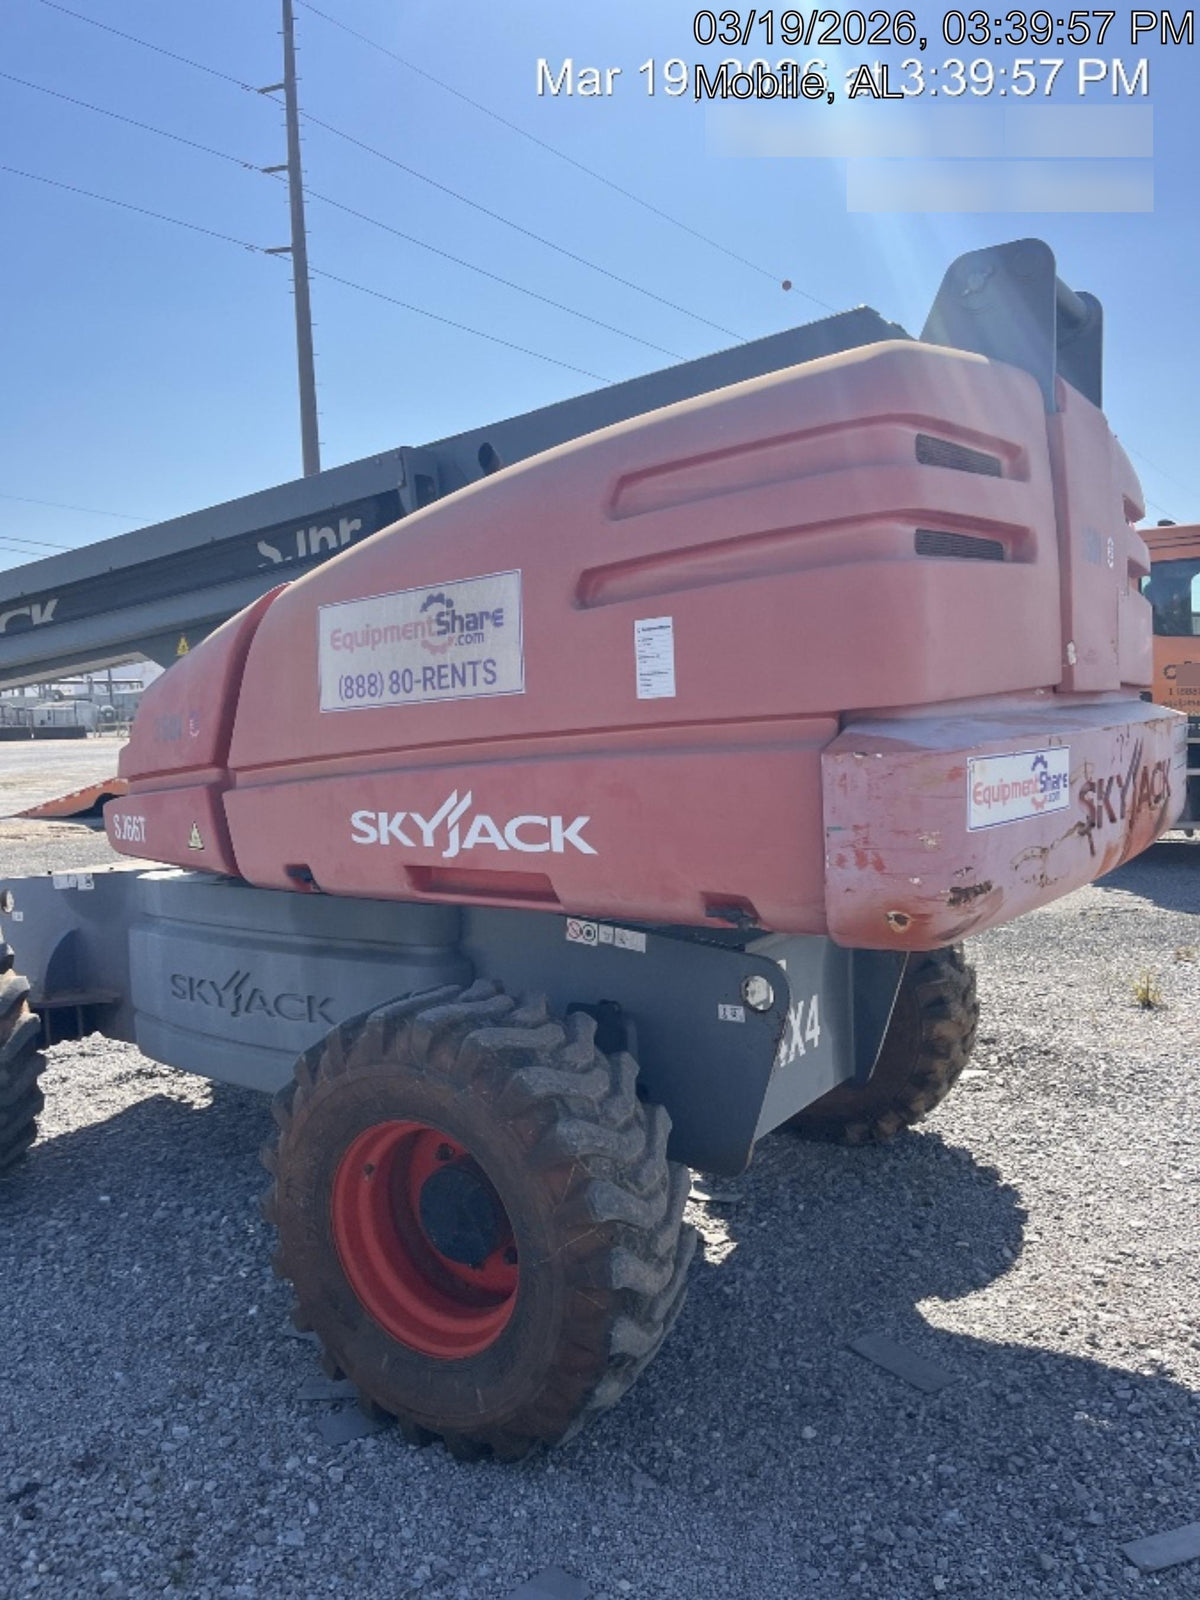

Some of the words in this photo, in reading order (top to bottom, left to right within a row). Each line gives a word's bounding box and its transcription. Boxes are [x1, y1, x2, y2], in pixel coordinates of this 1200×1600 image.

[330, 608, 504, 653] EquipmentShare
[338, 671, 384, 702] (888)
[389, 658, 497, 696] 80-RENTS
[1078, 737, 1171, 832] SKYJACK
[350, 788, 598, 858] SKYJACK
[171, 970, 338, 1025] SKYJACK
